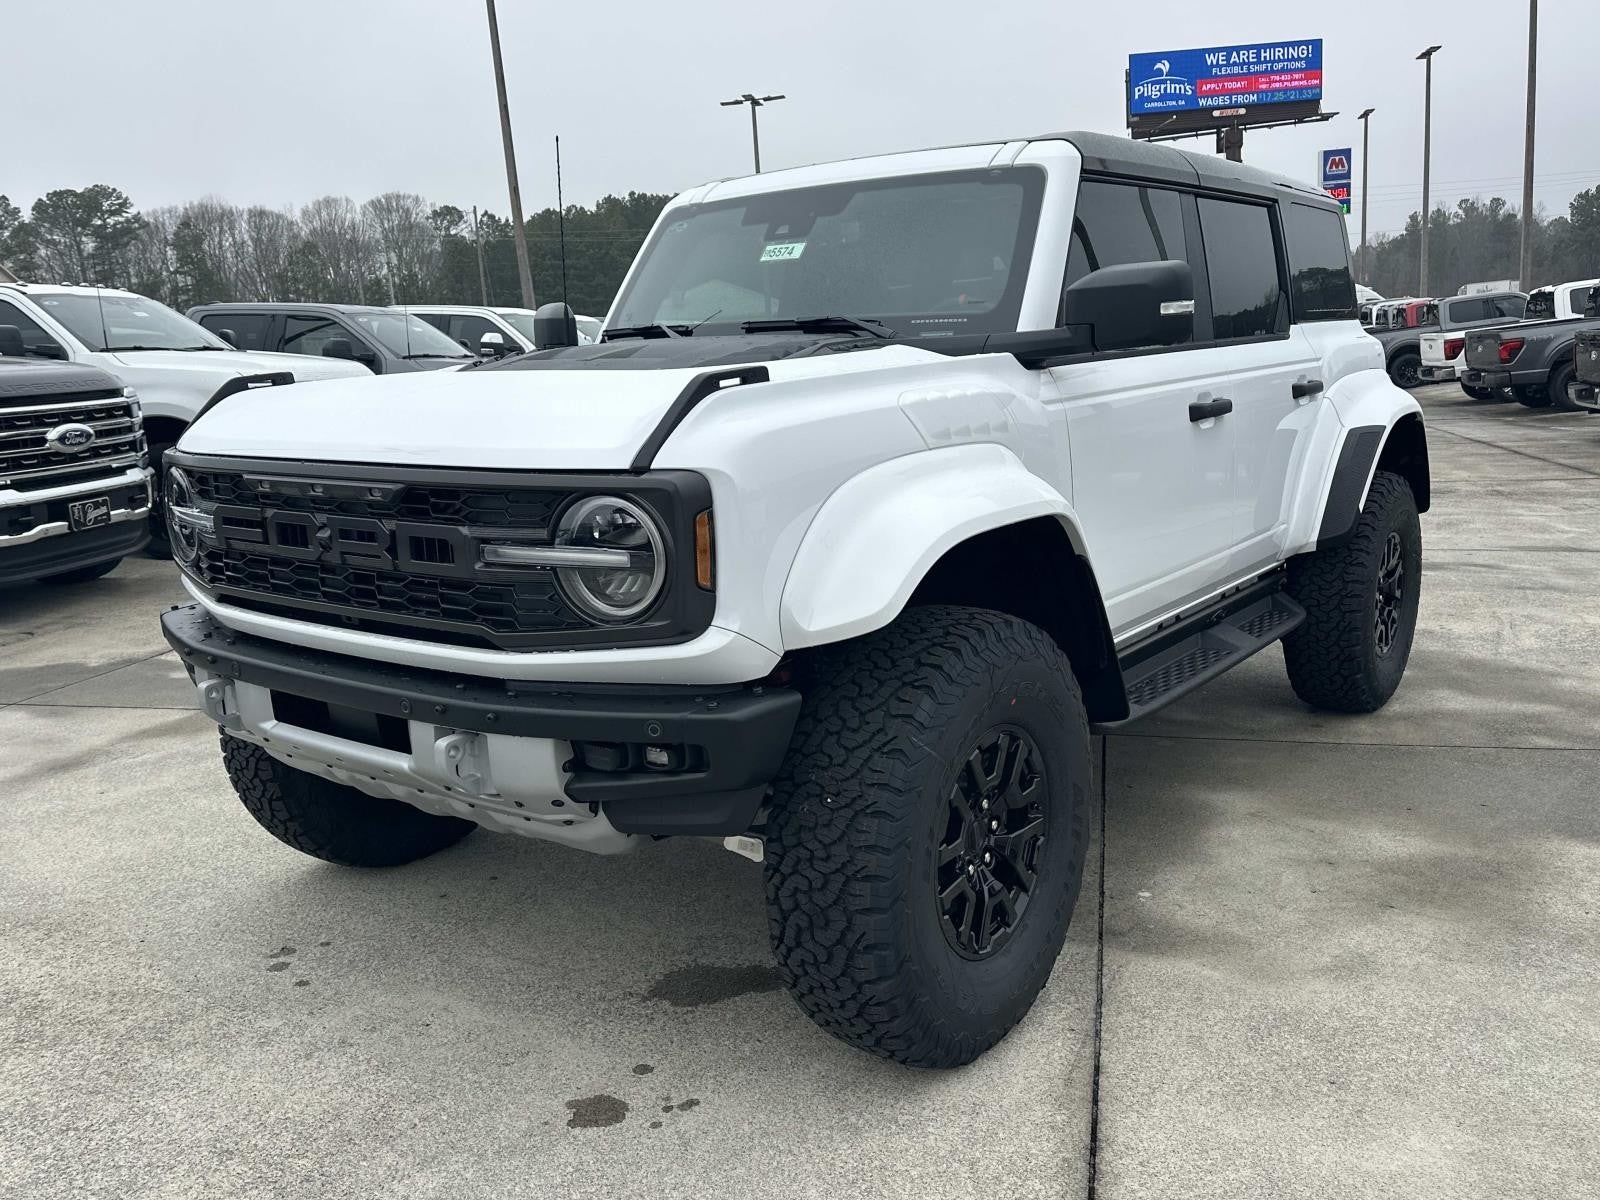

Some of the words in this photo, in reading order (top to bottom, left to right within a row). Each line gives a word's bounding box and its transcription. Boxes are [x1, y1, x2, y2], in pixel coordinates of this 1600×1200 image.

[1205, 52, 1226, 65] WE
[1230, 49, 1257, 63] ARE
[1261, 44, 1313, 61] HIRING!
[1212, 65, 1249, 75] FLEXIBLE
[1249, 63, 1272, 73] SHIFT
[1273, 60, 1306, 71] OPTIONS
[1134, 80, 1193, 99] Pilgrim's
[1201, 83, 1222, 91] APPLY
[1224, 81, 1248, 90] TODAY!
[1198, 96, 1231, 107] WAGES
[1232, 93, 1258, 104] FROM
[769, 246, 795, 258] 5574
[0, 382, 57, 394] UPER
[65, 431, 86, 445] Ford
[212, 503, 470, 581] FORD
